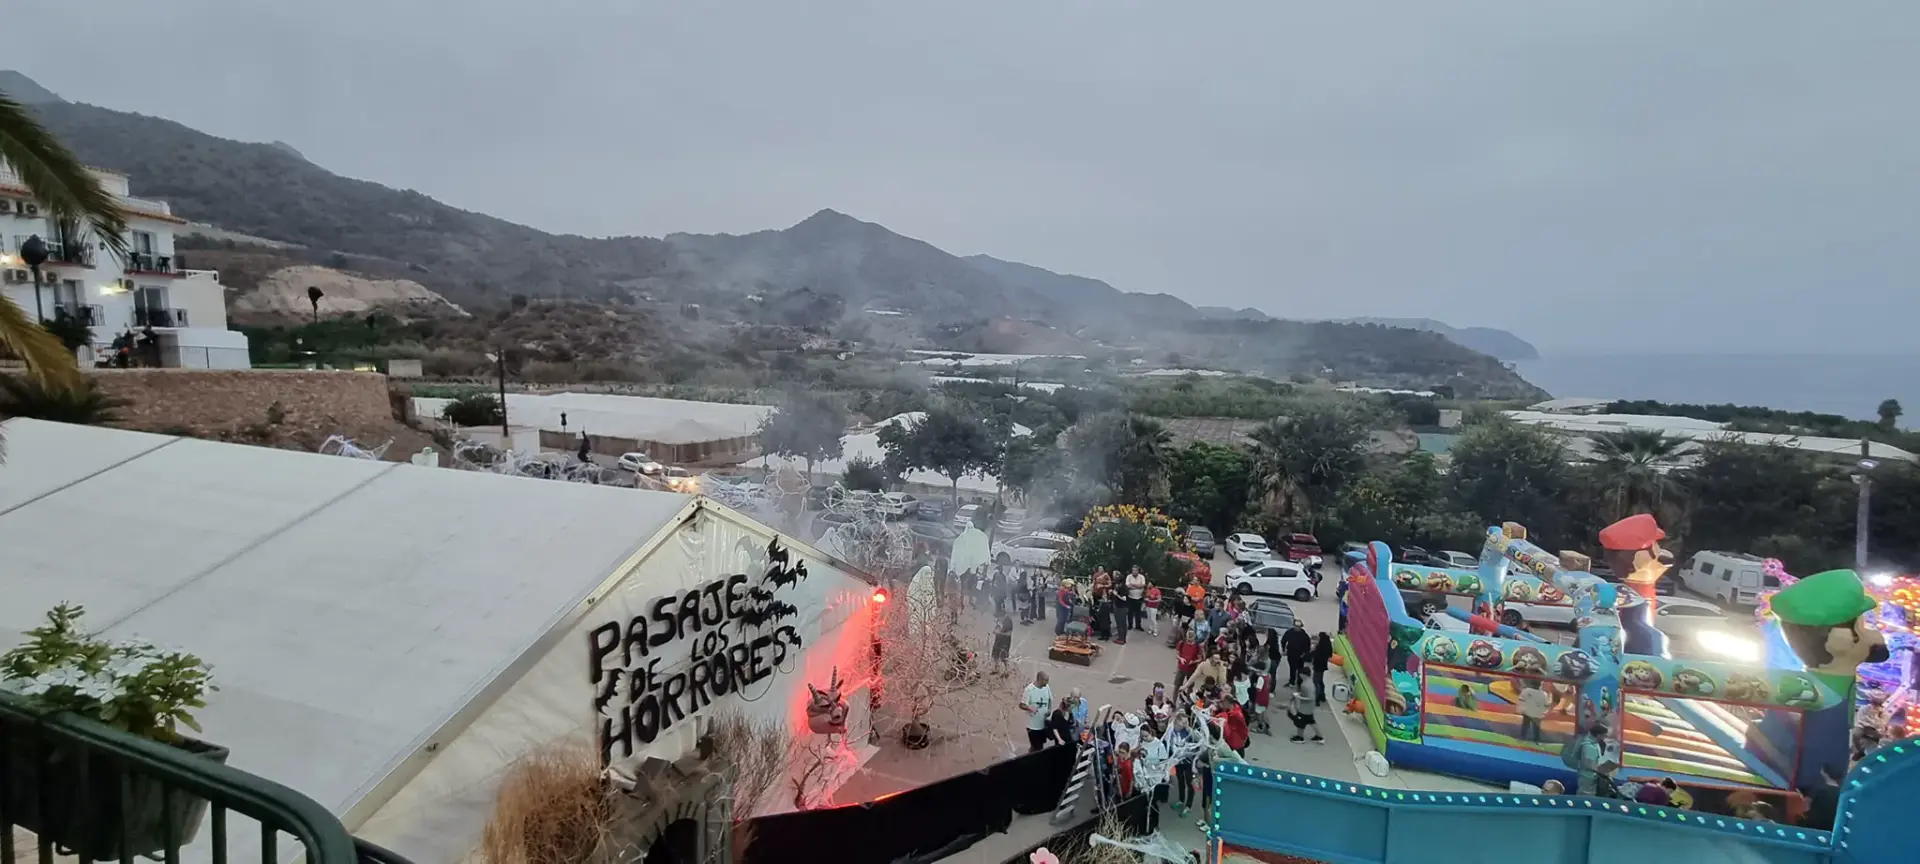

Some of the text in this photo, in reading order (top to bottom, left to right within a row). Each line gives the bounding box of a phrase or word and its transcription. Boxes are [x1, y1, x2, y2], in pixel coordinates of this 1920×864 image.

[589, 574, 748, 684] PASAJE
[631, 620, 731, 703] DE LOS
[601, 624, 791, 768] HORRORES
